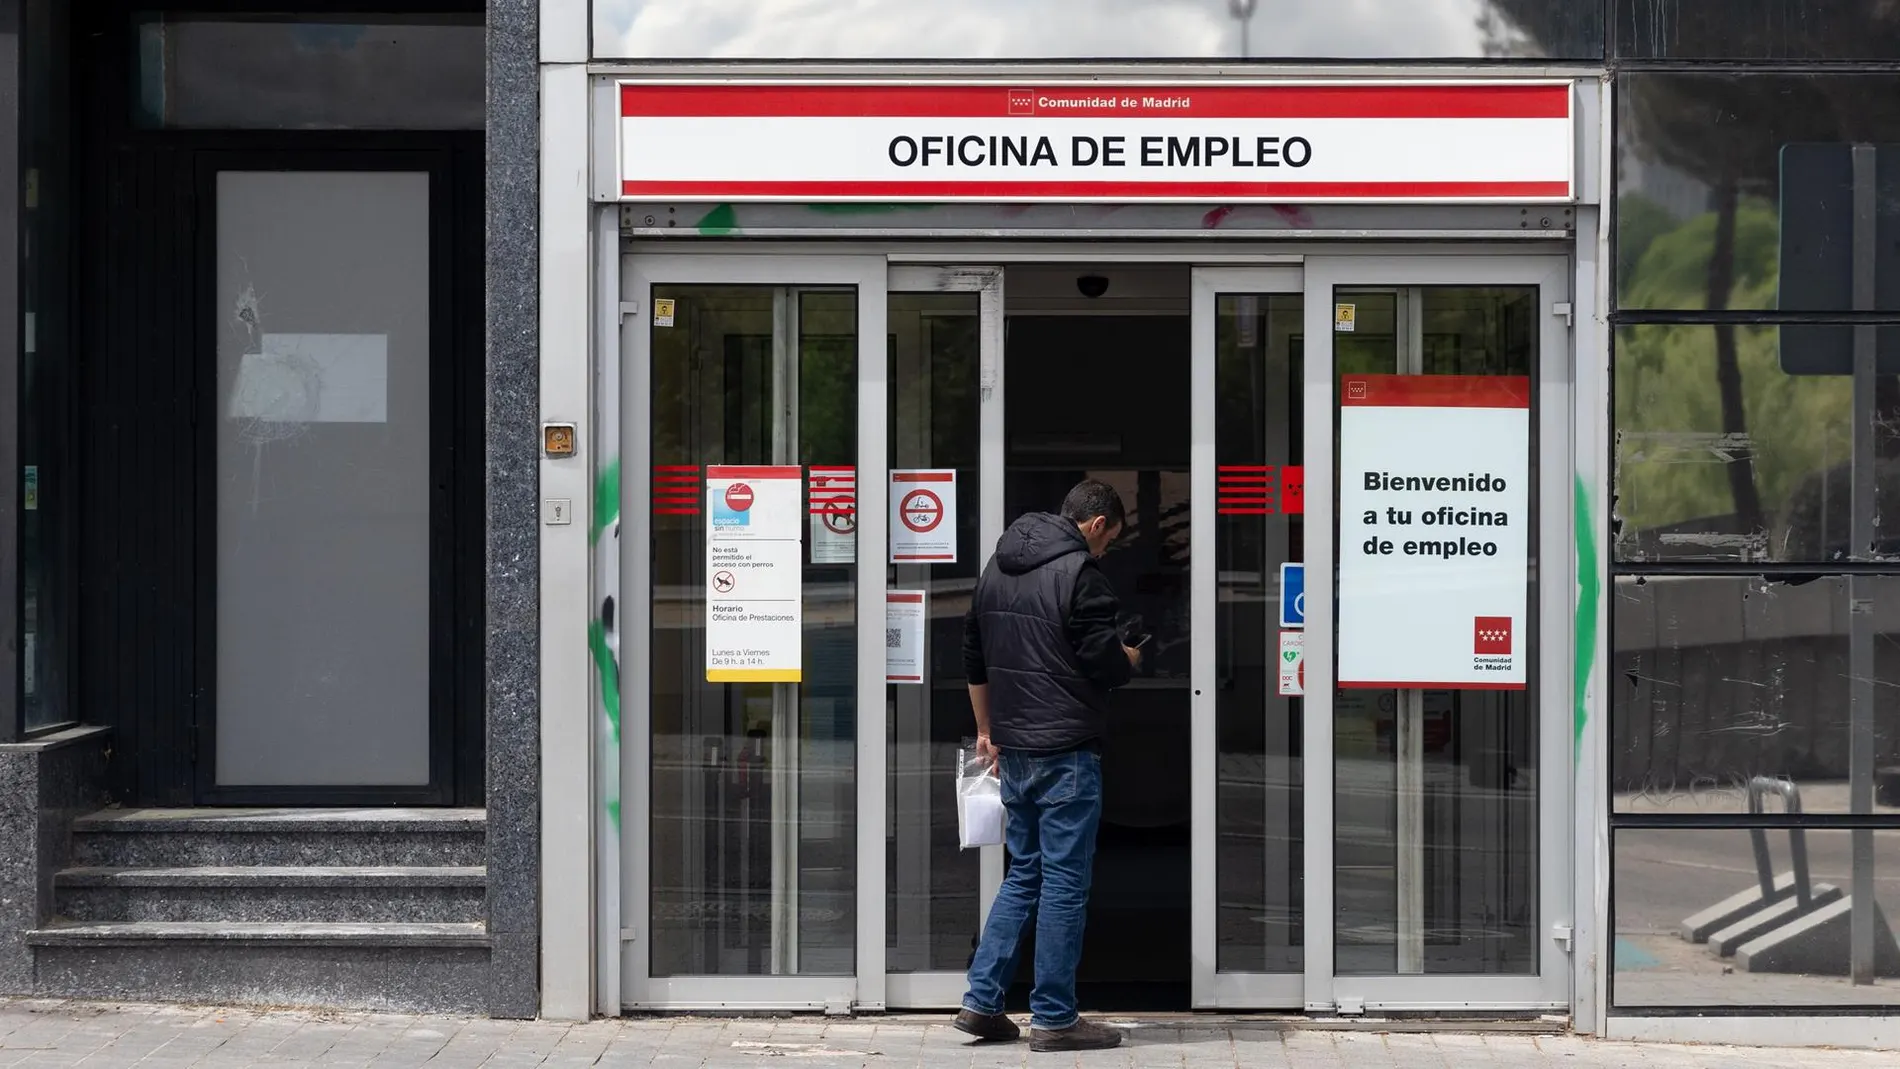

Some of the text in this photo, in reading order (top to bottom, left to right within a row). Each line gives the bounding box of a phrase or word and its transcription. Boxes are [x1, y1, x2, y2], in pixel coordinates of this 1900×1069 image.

[1038, 96, 1190, 108] Comunidad de Madrid
[888, 135, 1312, 168] OFICINA DE EMPLEO
[1364, 471, 1507, 493] Bienvenido
[1363, 506, 1508, 527] a tu oficina
[1363, 535, 1498, 560] de empleo
[712, 613, 795, 621] Oficina de Prestaciones
[712, 648, 735, 656] Lunes
[743, 648, 771, 656] Viernes
